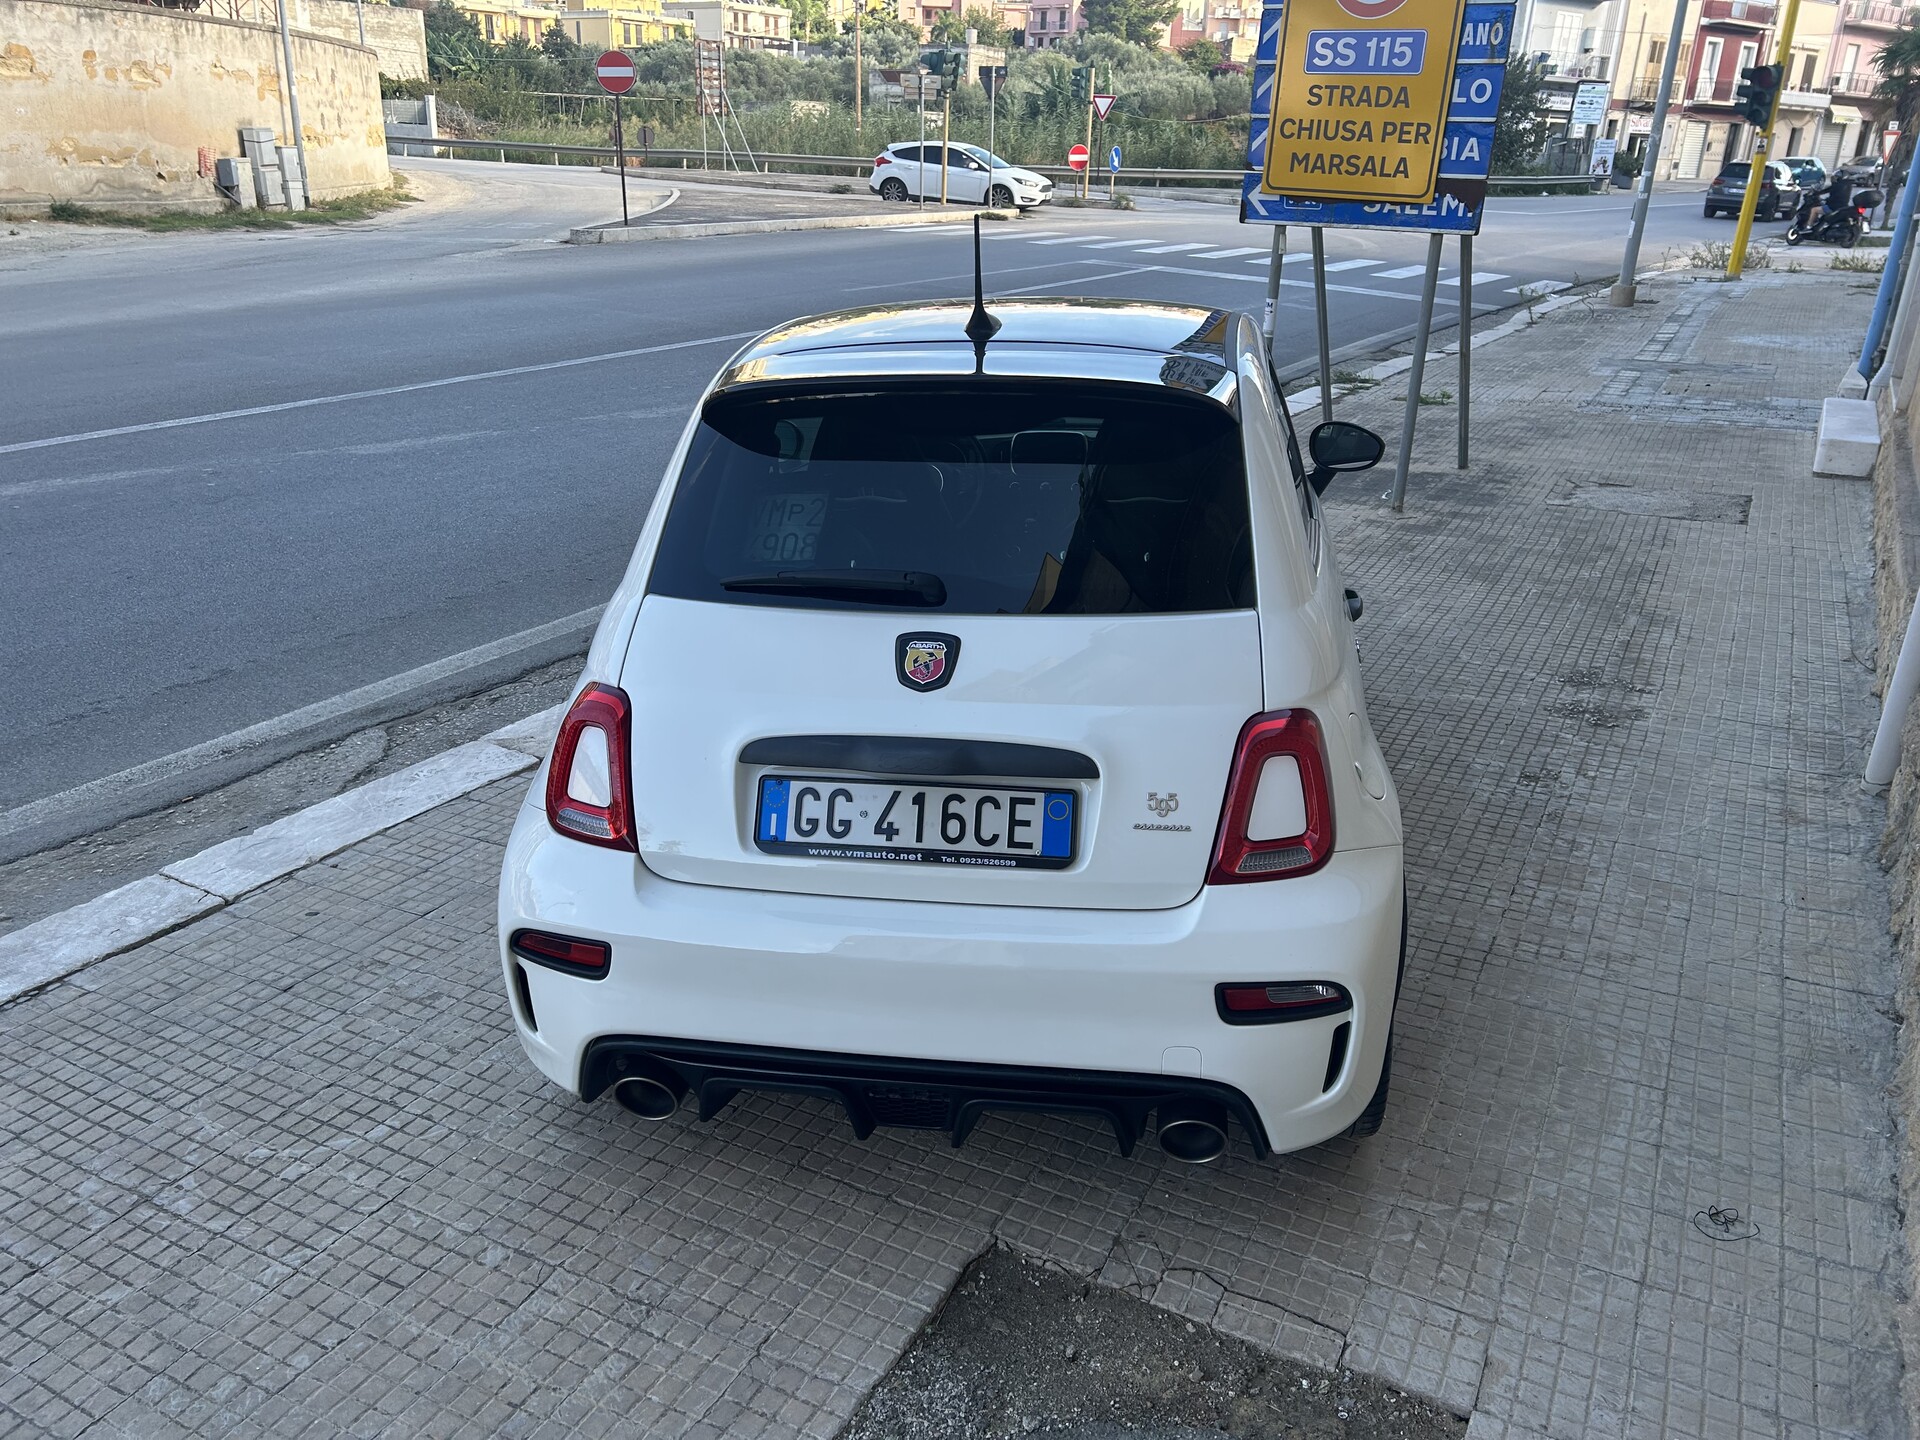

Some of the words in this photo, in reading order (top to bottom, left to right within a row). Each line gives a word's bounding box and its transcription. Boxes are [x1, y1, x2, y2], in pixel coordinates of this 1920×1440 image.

[1312, 37, 1357, 67] SS
[1366, 37, 1414, 67] 115
[1307, 84, 1411, 109] STRADA
[1280, 118, 1374, 143] CHIUSA
[1381, 122, 1432, 145] PER
[1289, 152, 1410, 179] MARSALA
[1363, 193, 1473, 217] ALEM
[793, 786, 853, 839] GG
[873, 790, 1037, 850] 416CE
[808, 847, 923, 862] www.vmauto.net
[941, 855, 957, 864] Tel.
[959, 856, 1017, 867] 0923/526599
